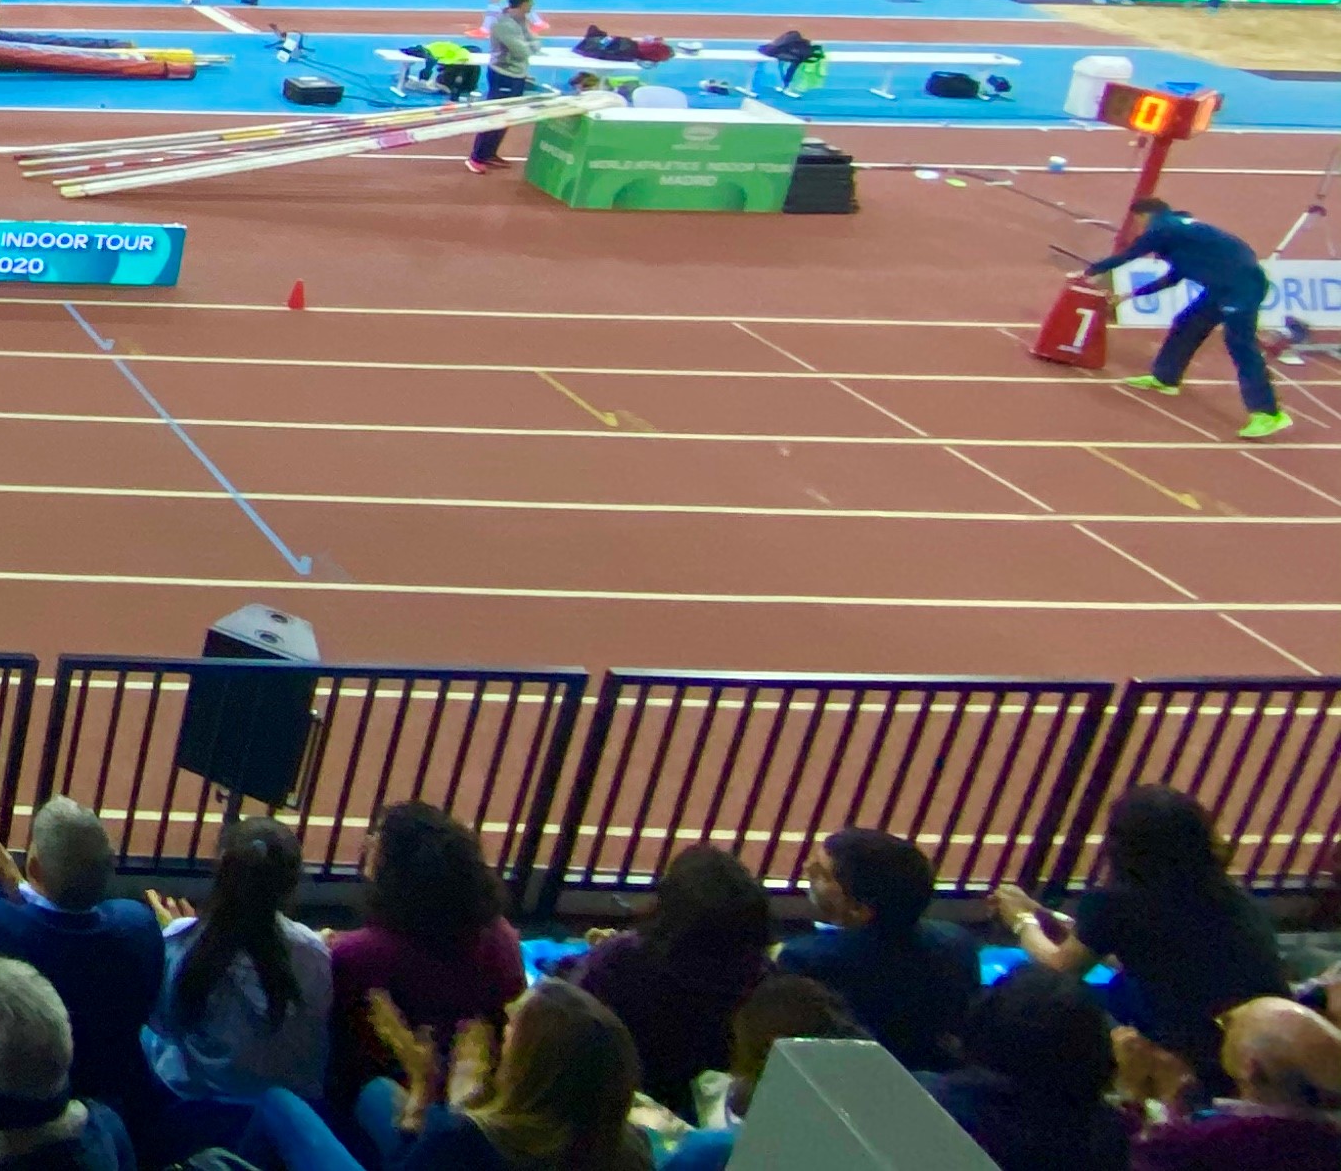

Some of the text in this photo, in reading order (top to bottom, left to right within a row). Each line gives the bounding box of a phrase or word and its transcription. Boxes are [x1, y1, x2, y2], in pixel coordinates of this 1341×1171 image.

[1135, 95, 1166, 132] 0
[1, 231, 87, 249] INDOOR
[93, 233, 153, 251] TOUR
[1058, 308, 1096, 353] 1
